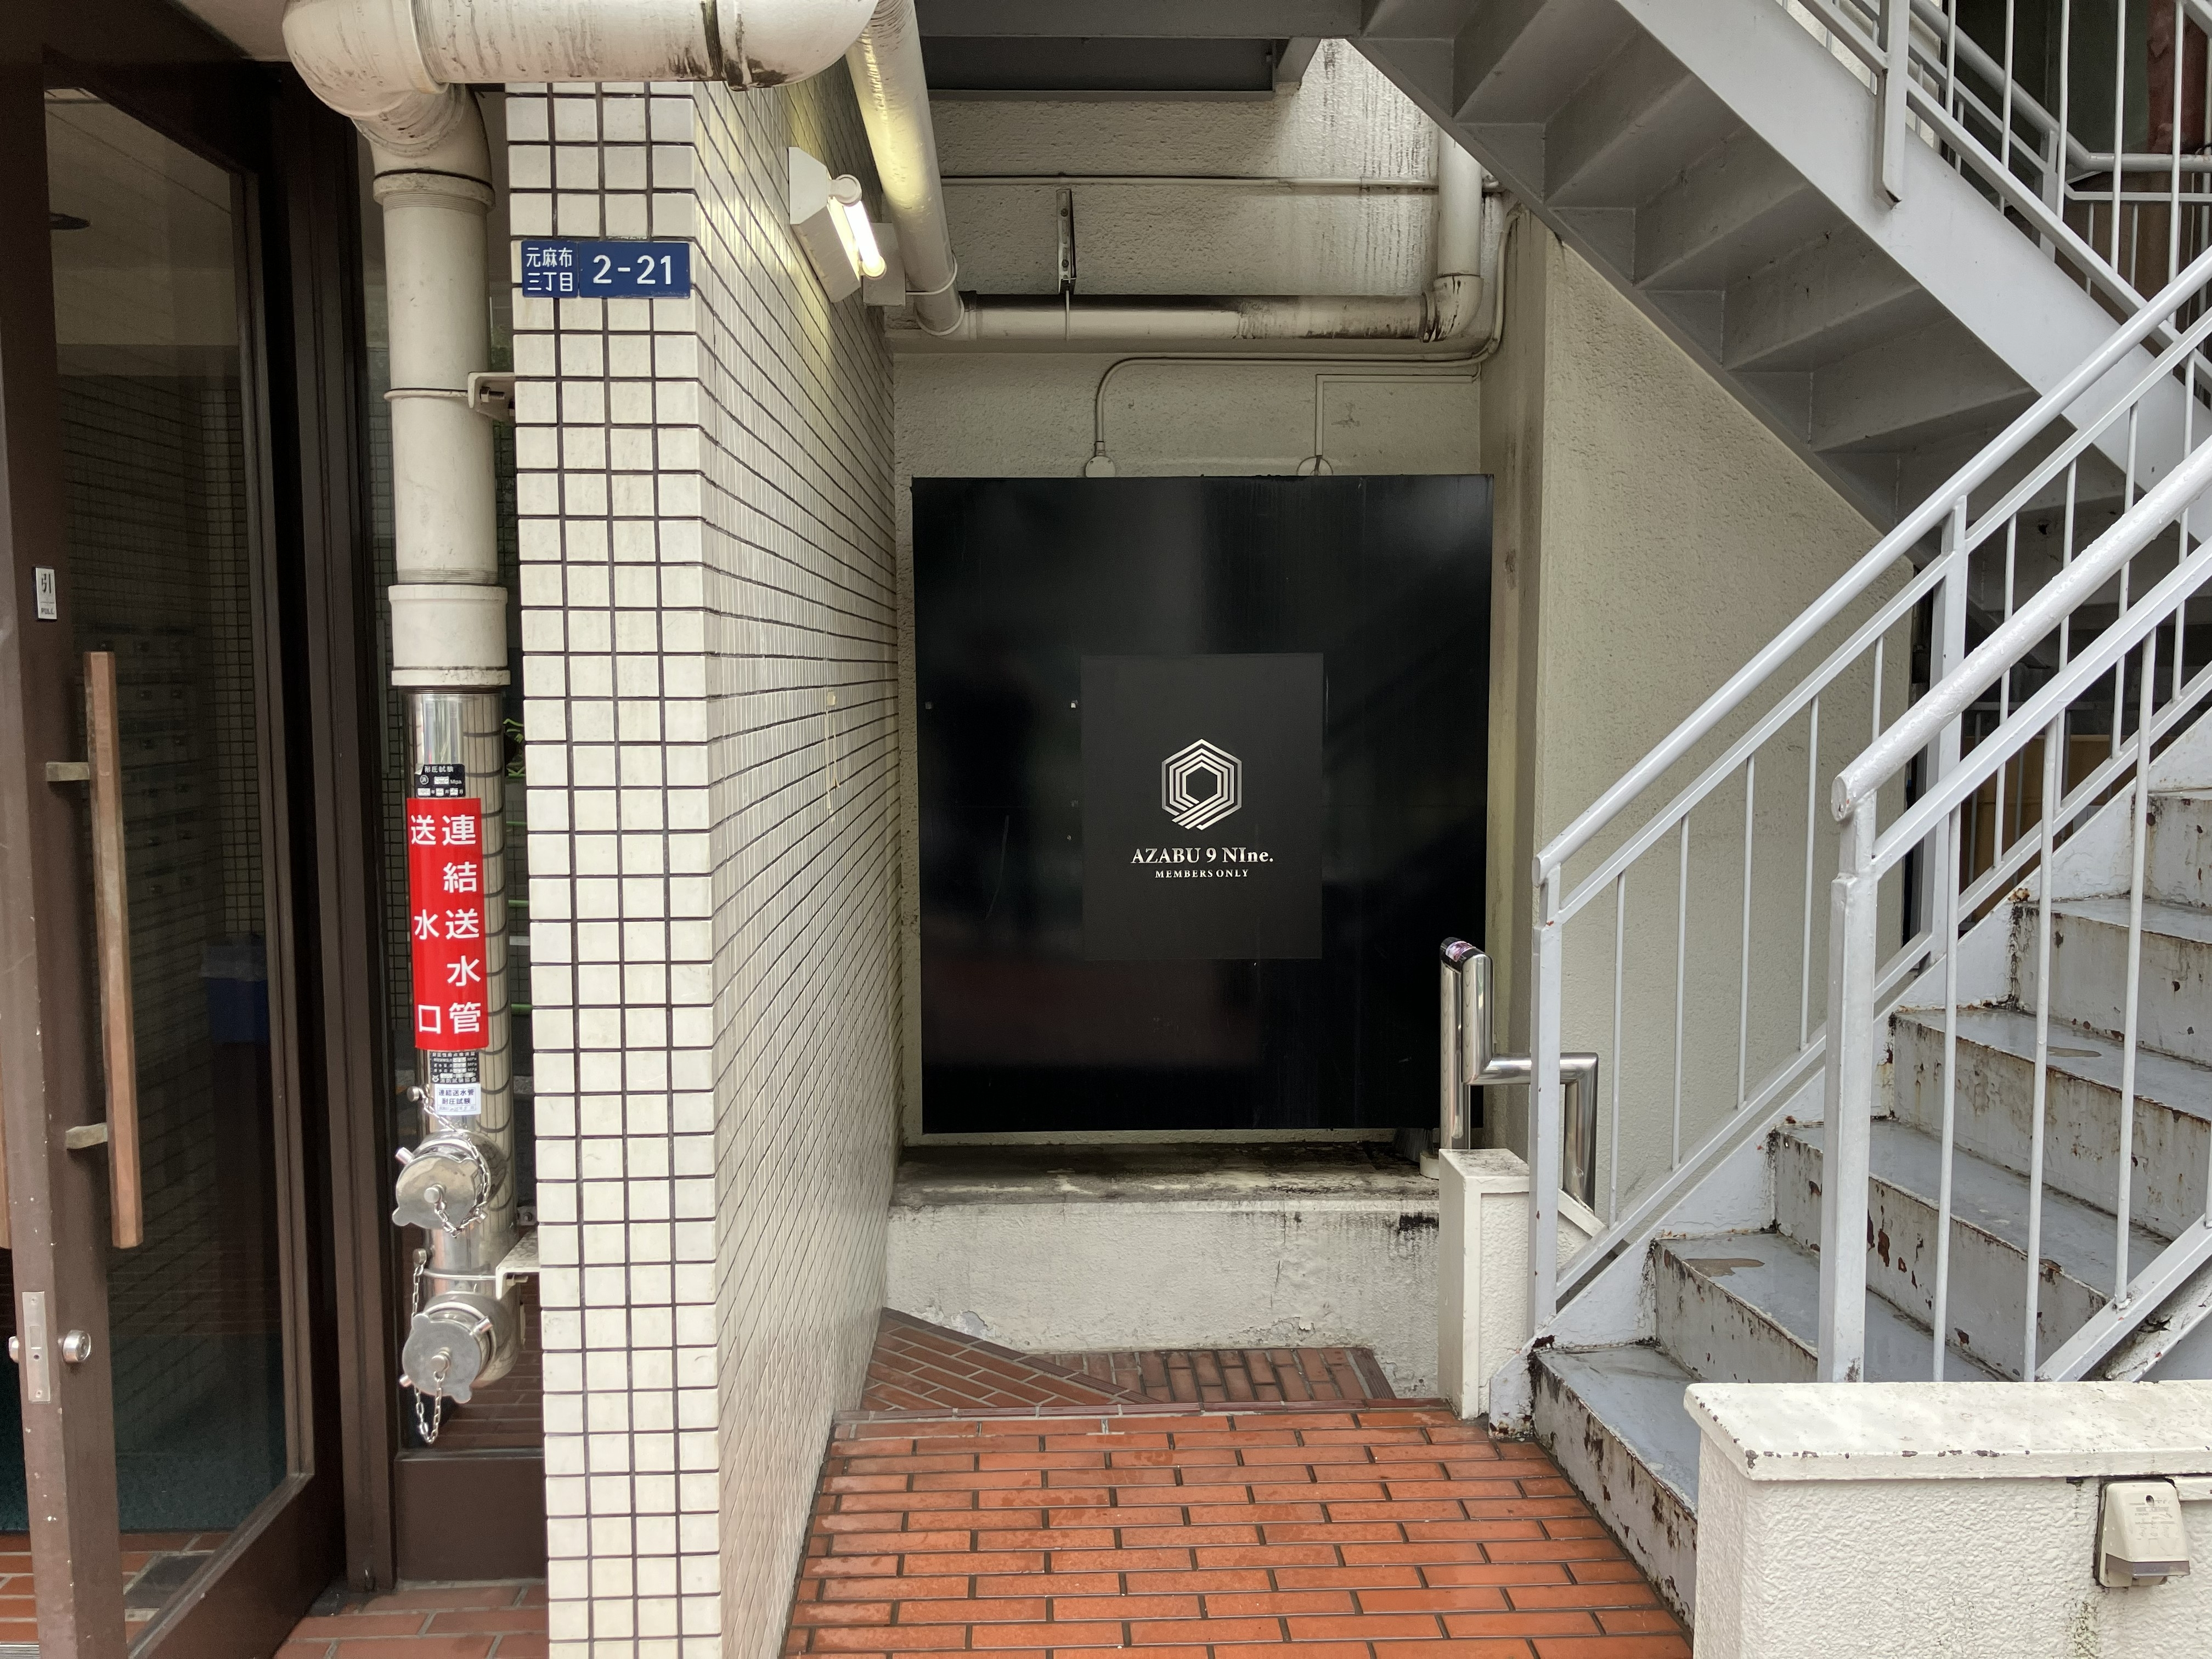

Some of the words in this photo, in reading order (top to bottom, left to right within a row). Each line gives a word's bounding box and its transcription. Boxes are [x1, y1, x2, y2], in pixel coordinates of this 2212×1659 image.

[526, 247, 573, 268] 元麻布
[592, 255, 672, 285] 2-21
[527, 272, 573, 292] 三丁目
[41, 573, 52, 594] 引
[1130, 848, 1201, 864] AZABU
[1206, 848, 1217, 863] 9
[1155, 870, 1213, 878] MEMBERS
[1216, 869, 1249, 877] ONLY
[411, 815, 441, 1035] 送水口
[442, 814, 481, 1035] 連結送水管
